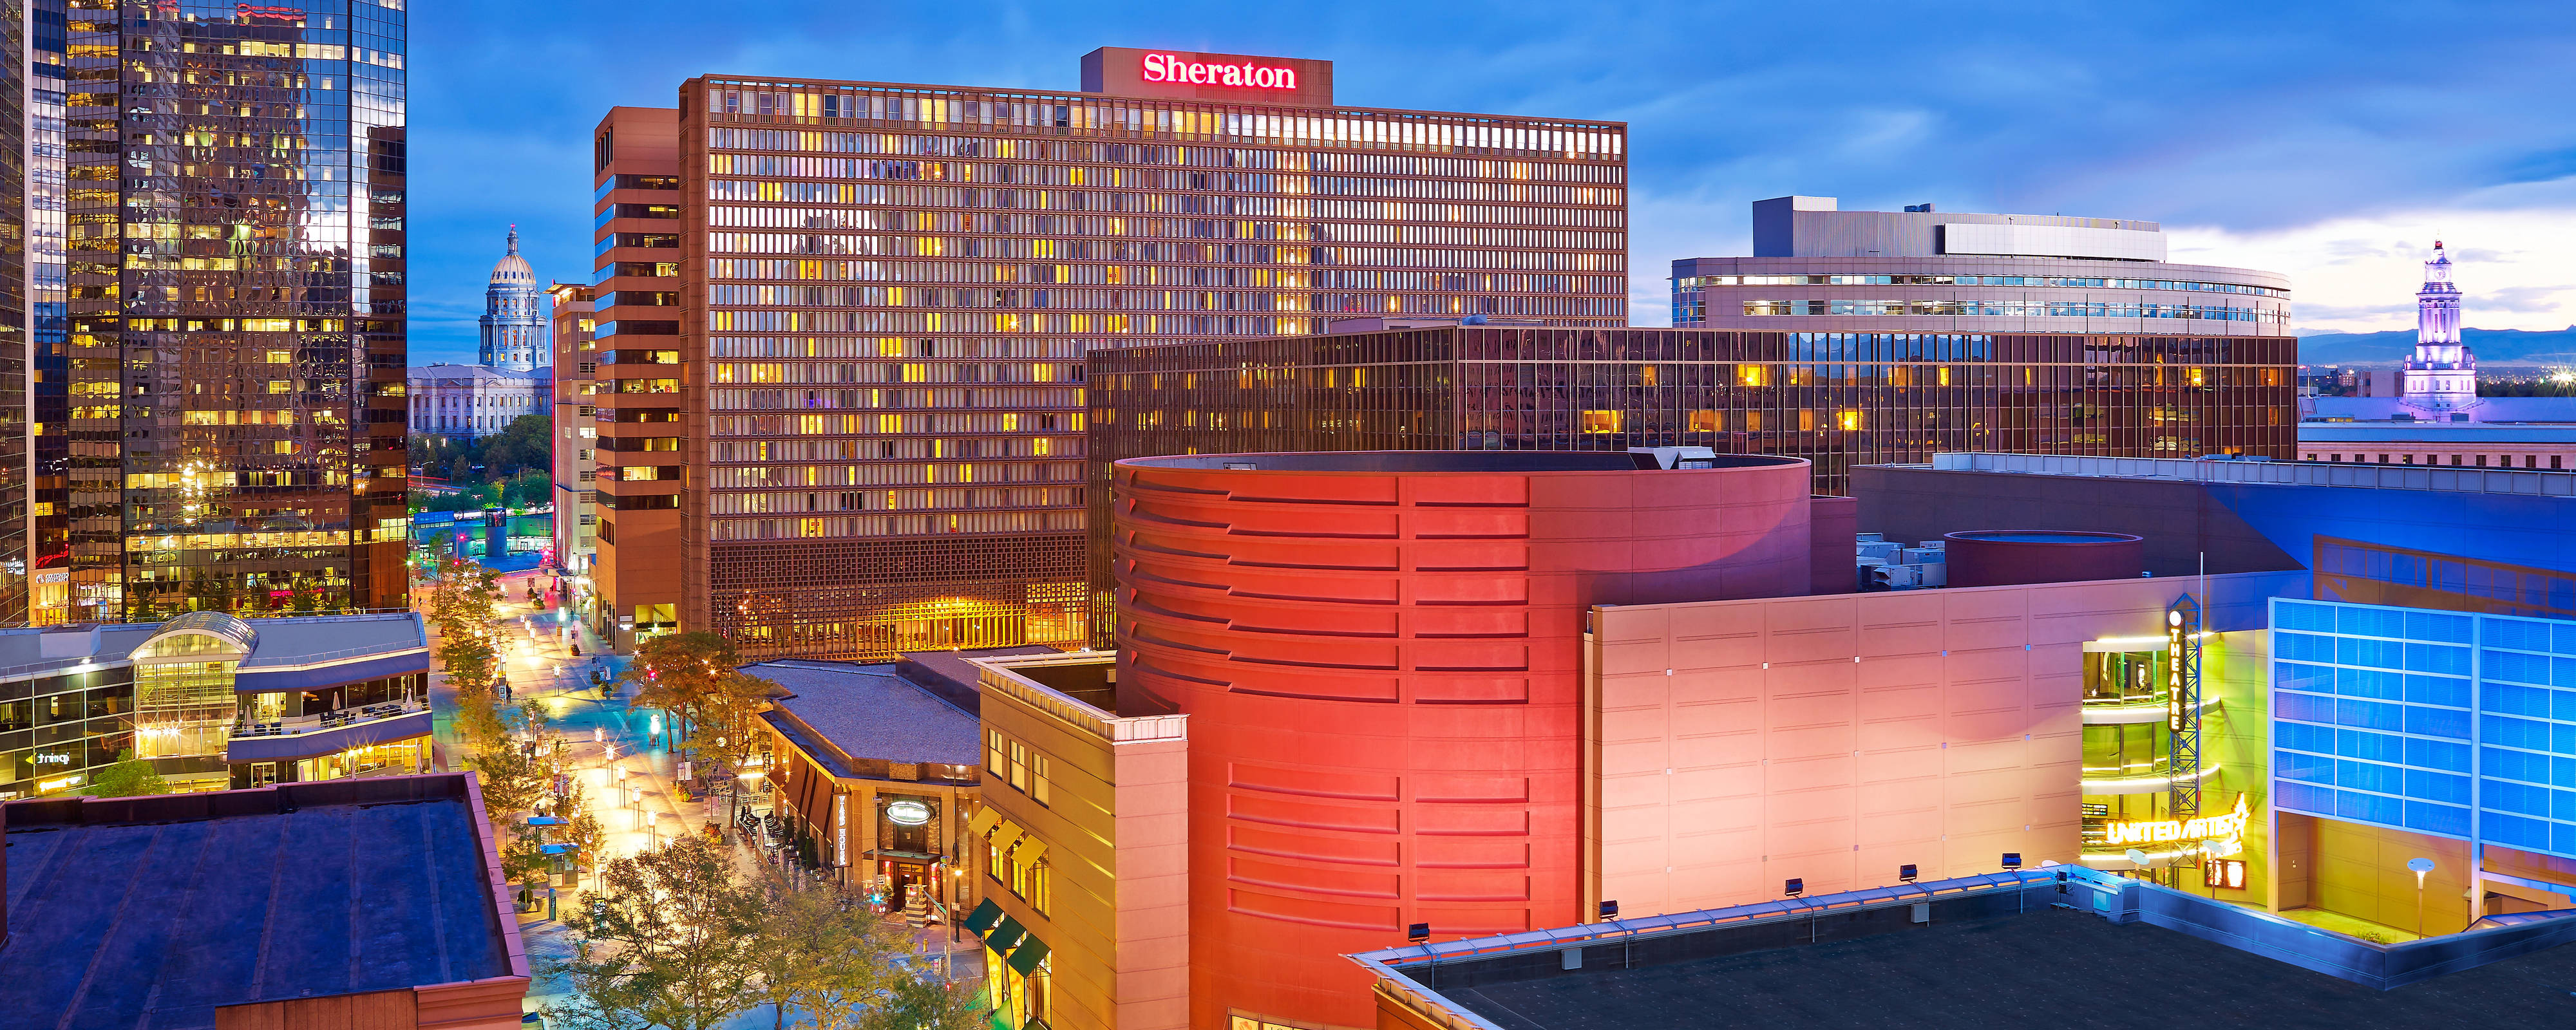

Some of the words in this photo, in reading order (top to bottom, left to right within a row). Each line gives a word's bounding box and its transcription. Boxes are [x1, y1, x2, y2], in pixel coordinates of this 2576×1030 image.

[1144, 53, 1296, 89] Sheraton
[2170, 628, 2180, 730] THEATRE
[2107, 820, 2181, 845] UNITED
